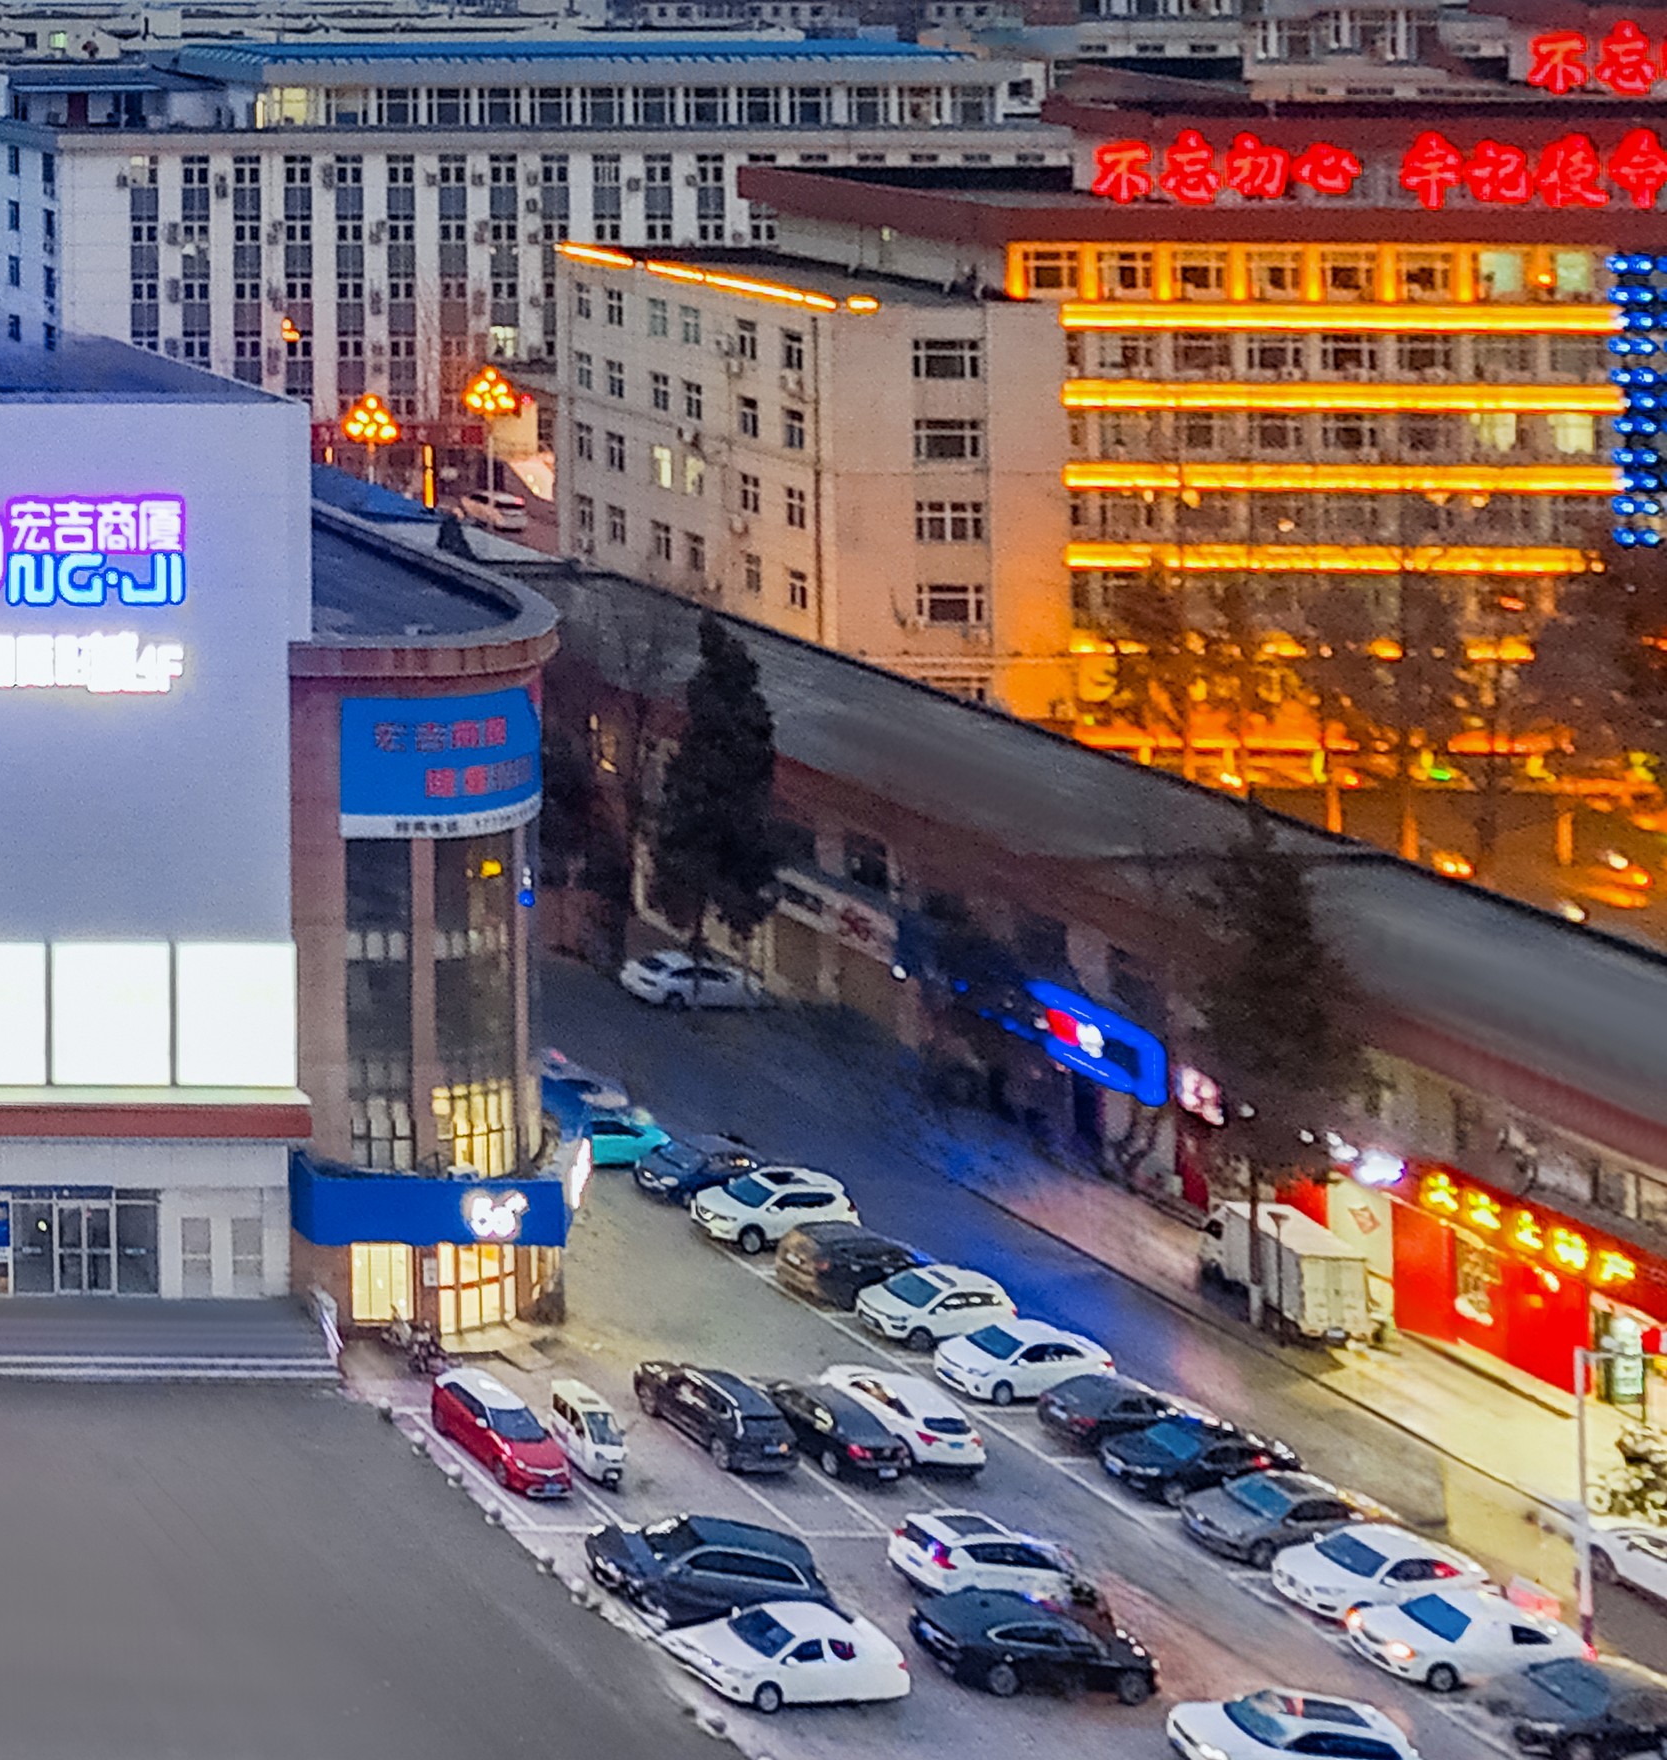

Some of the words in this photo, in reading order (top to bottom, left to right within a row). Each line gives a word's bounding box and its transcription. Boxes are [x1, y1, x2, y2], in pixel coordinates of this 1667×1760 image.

[1528, 20, 1667, 96] 不忘
[1092, 129, 1363, 205] 不忘初心
[1400, 128, 1667, 210] 牢记使命
[8, 500, 183, 553] 宏吉商厦
